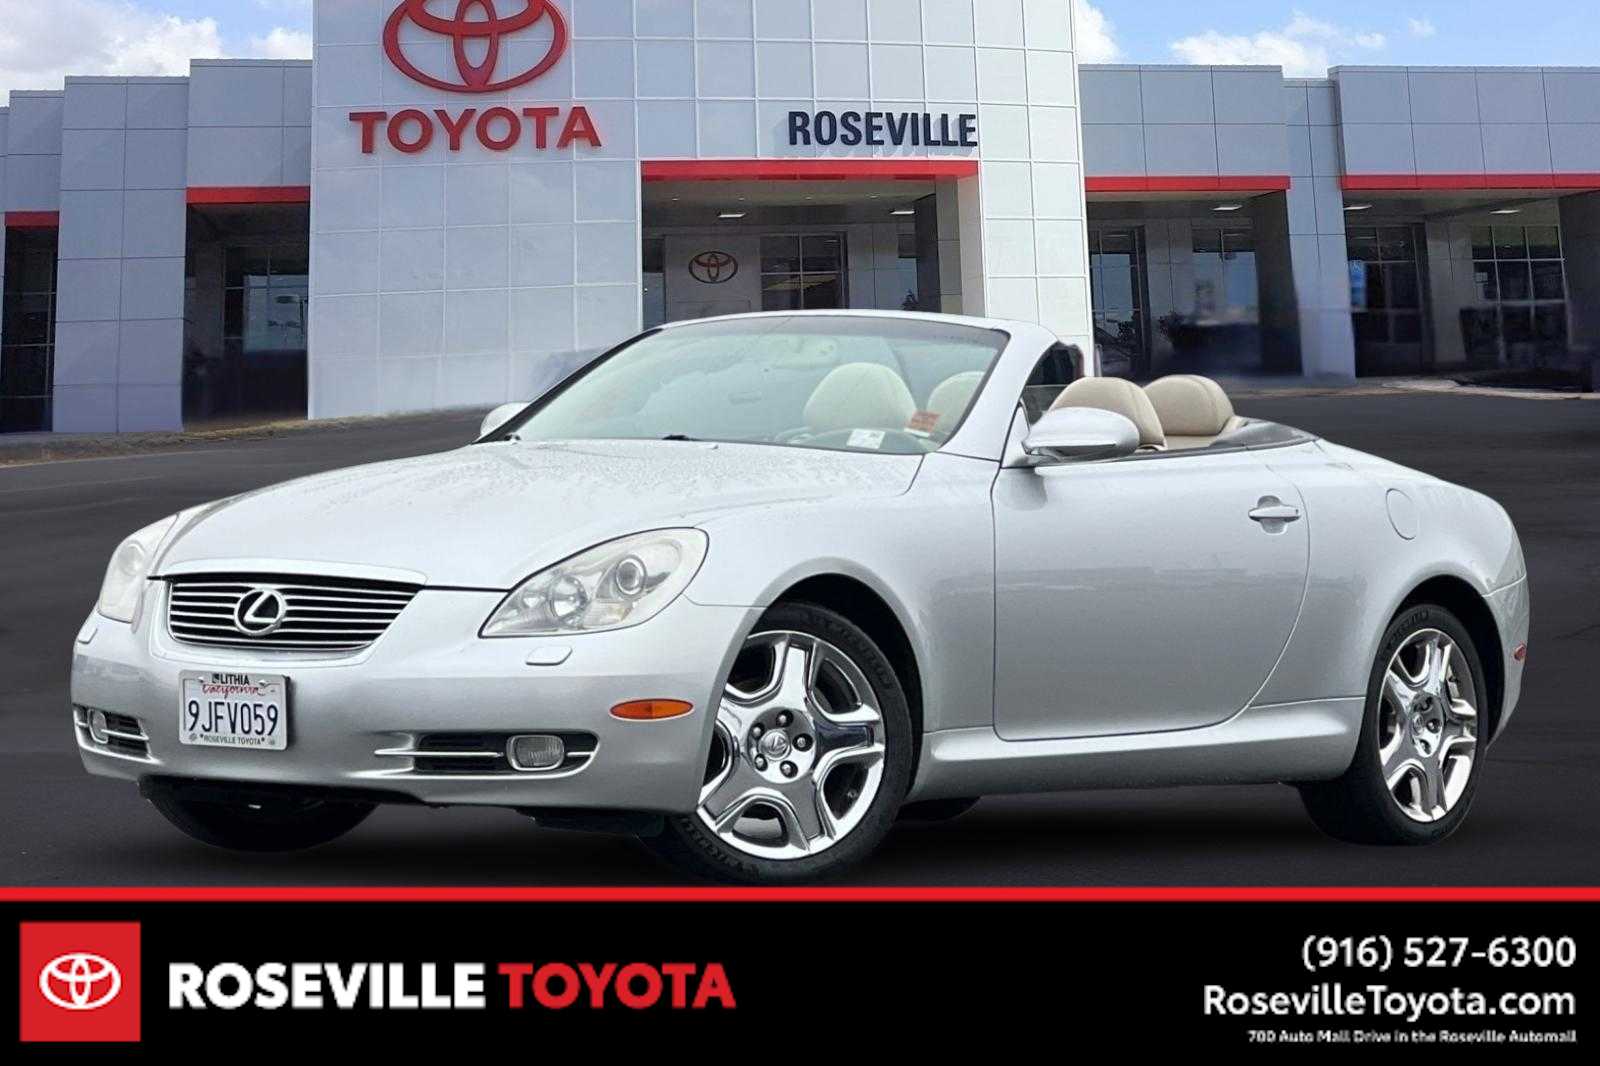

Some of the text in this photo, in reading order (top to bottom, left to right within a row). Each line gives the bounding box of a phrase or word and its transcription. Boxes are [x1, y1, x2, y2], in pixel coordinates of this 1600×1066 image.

[349, 106, 602, 154] TOYOTA
[789, 111, 978, 147] ROSEVILLE
[220, 673, 250, 686] LITHIA
[188, 700, 279, 736] 9JFV059
[238, 737, 261, 746] TOYOTA
